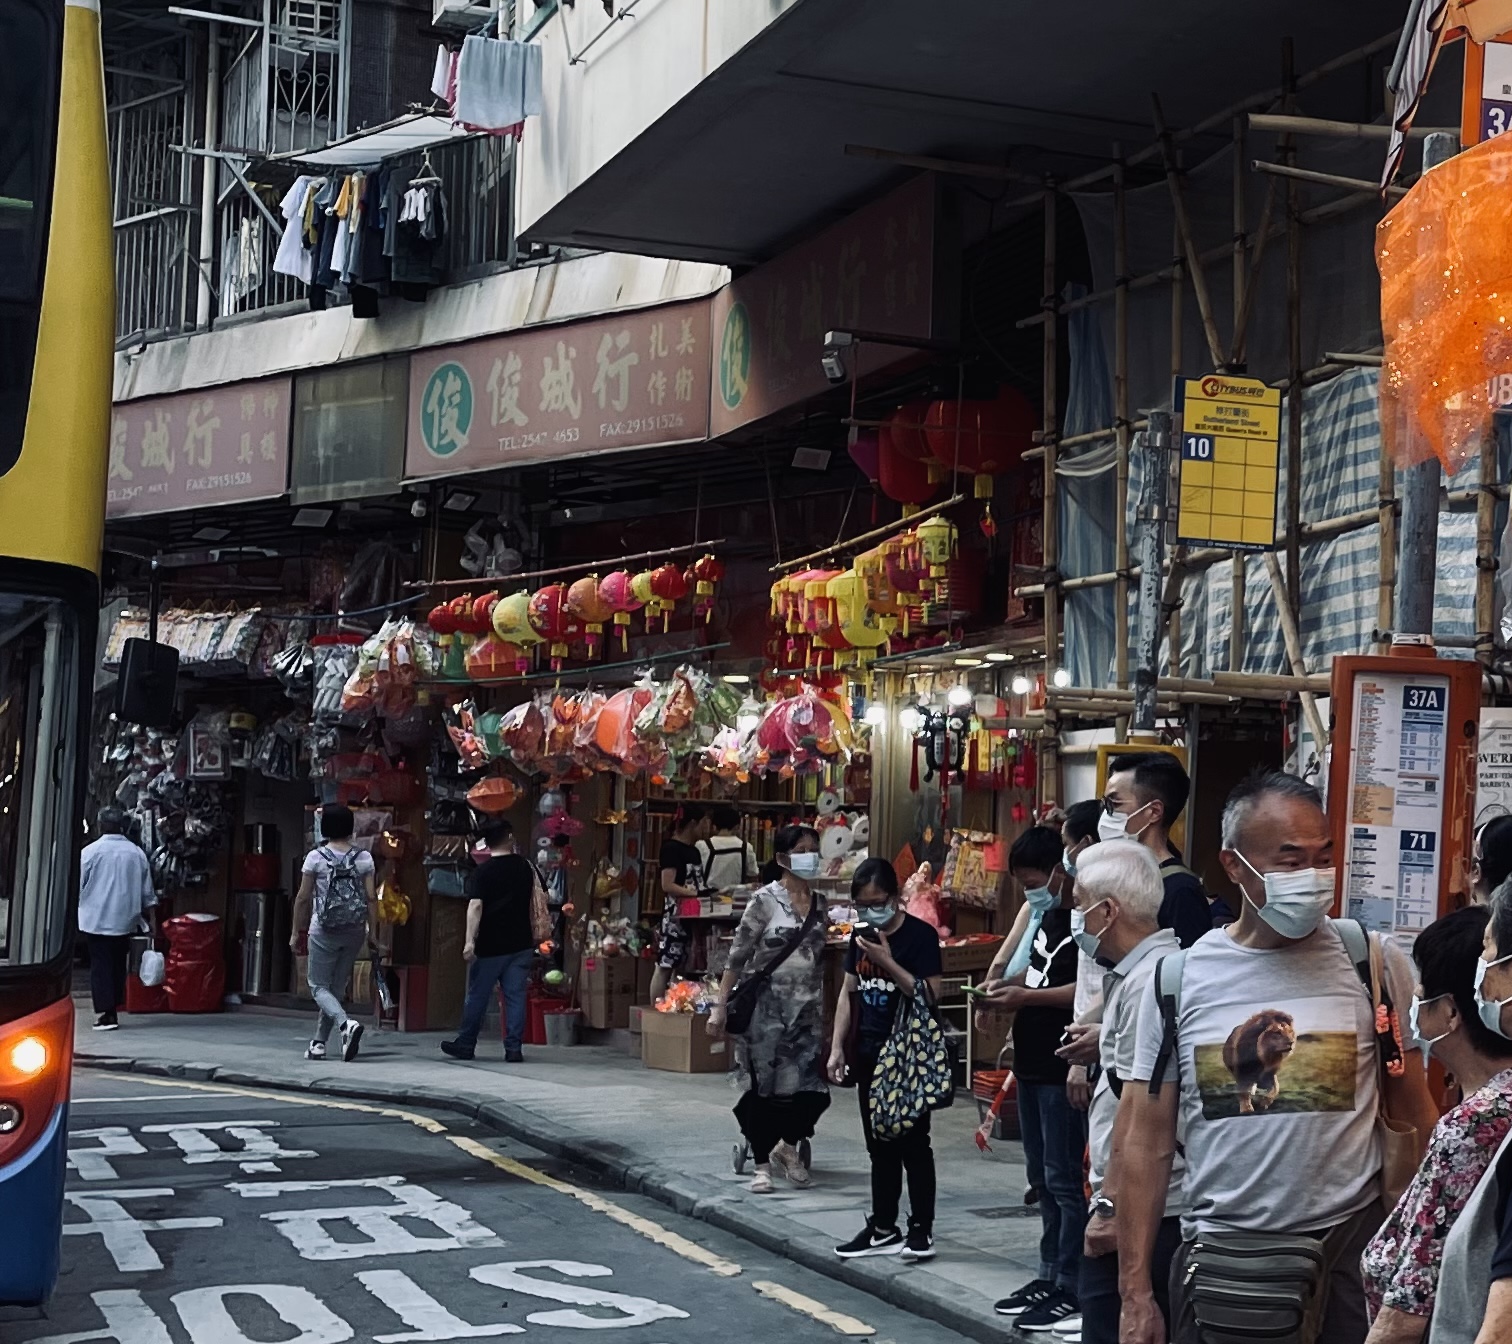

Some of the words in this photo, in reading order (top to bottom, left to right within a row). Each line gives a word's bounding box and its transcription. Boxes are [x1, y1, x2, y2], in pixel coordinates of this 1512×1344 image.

[486, 329, 640, 429] 俊城行
[427, 369, 470, 449] 俊
[1187, 437, 1210, 458] 10
[1408, 689, 1439, 708] 37A
[1409, 832, 1427, 849] 71
